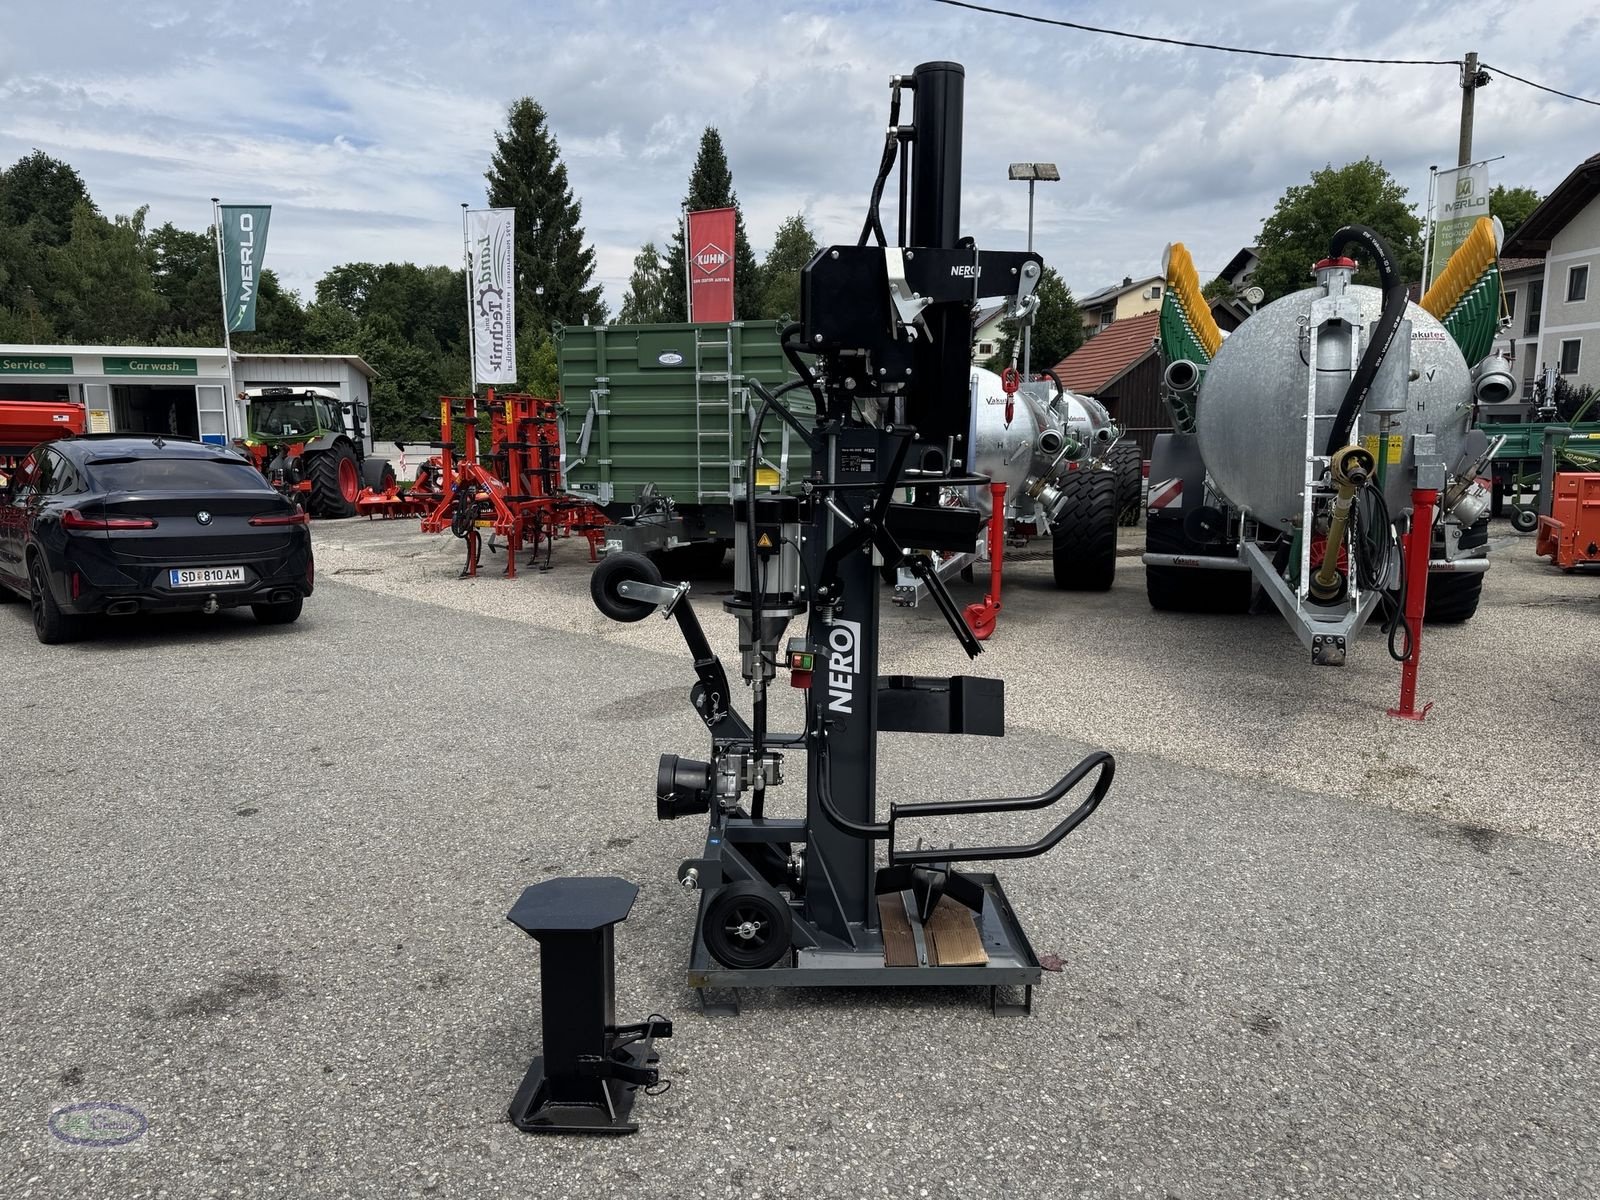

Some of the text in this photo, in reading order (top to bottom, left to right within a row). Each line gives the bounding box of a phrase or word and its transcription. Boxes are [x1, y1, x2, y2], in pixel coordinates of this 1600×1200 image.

[1444, 196, 1485, 213] MERLO
[239, 213, 253, 301] MERLO
[697, 254, 725, 265] KUHN
[3, 360, 46, 370] Service
[129, 361, 179, 371] Car wash
[1417, 401, 1425, 411] H
[1426, 423, 1433, 434] L
[181, 571, 196, 582] SD
[204, 570, 223, 581] 810
[225, 569, 240, 580] AM
[828, 628, 854, 714] NERO
